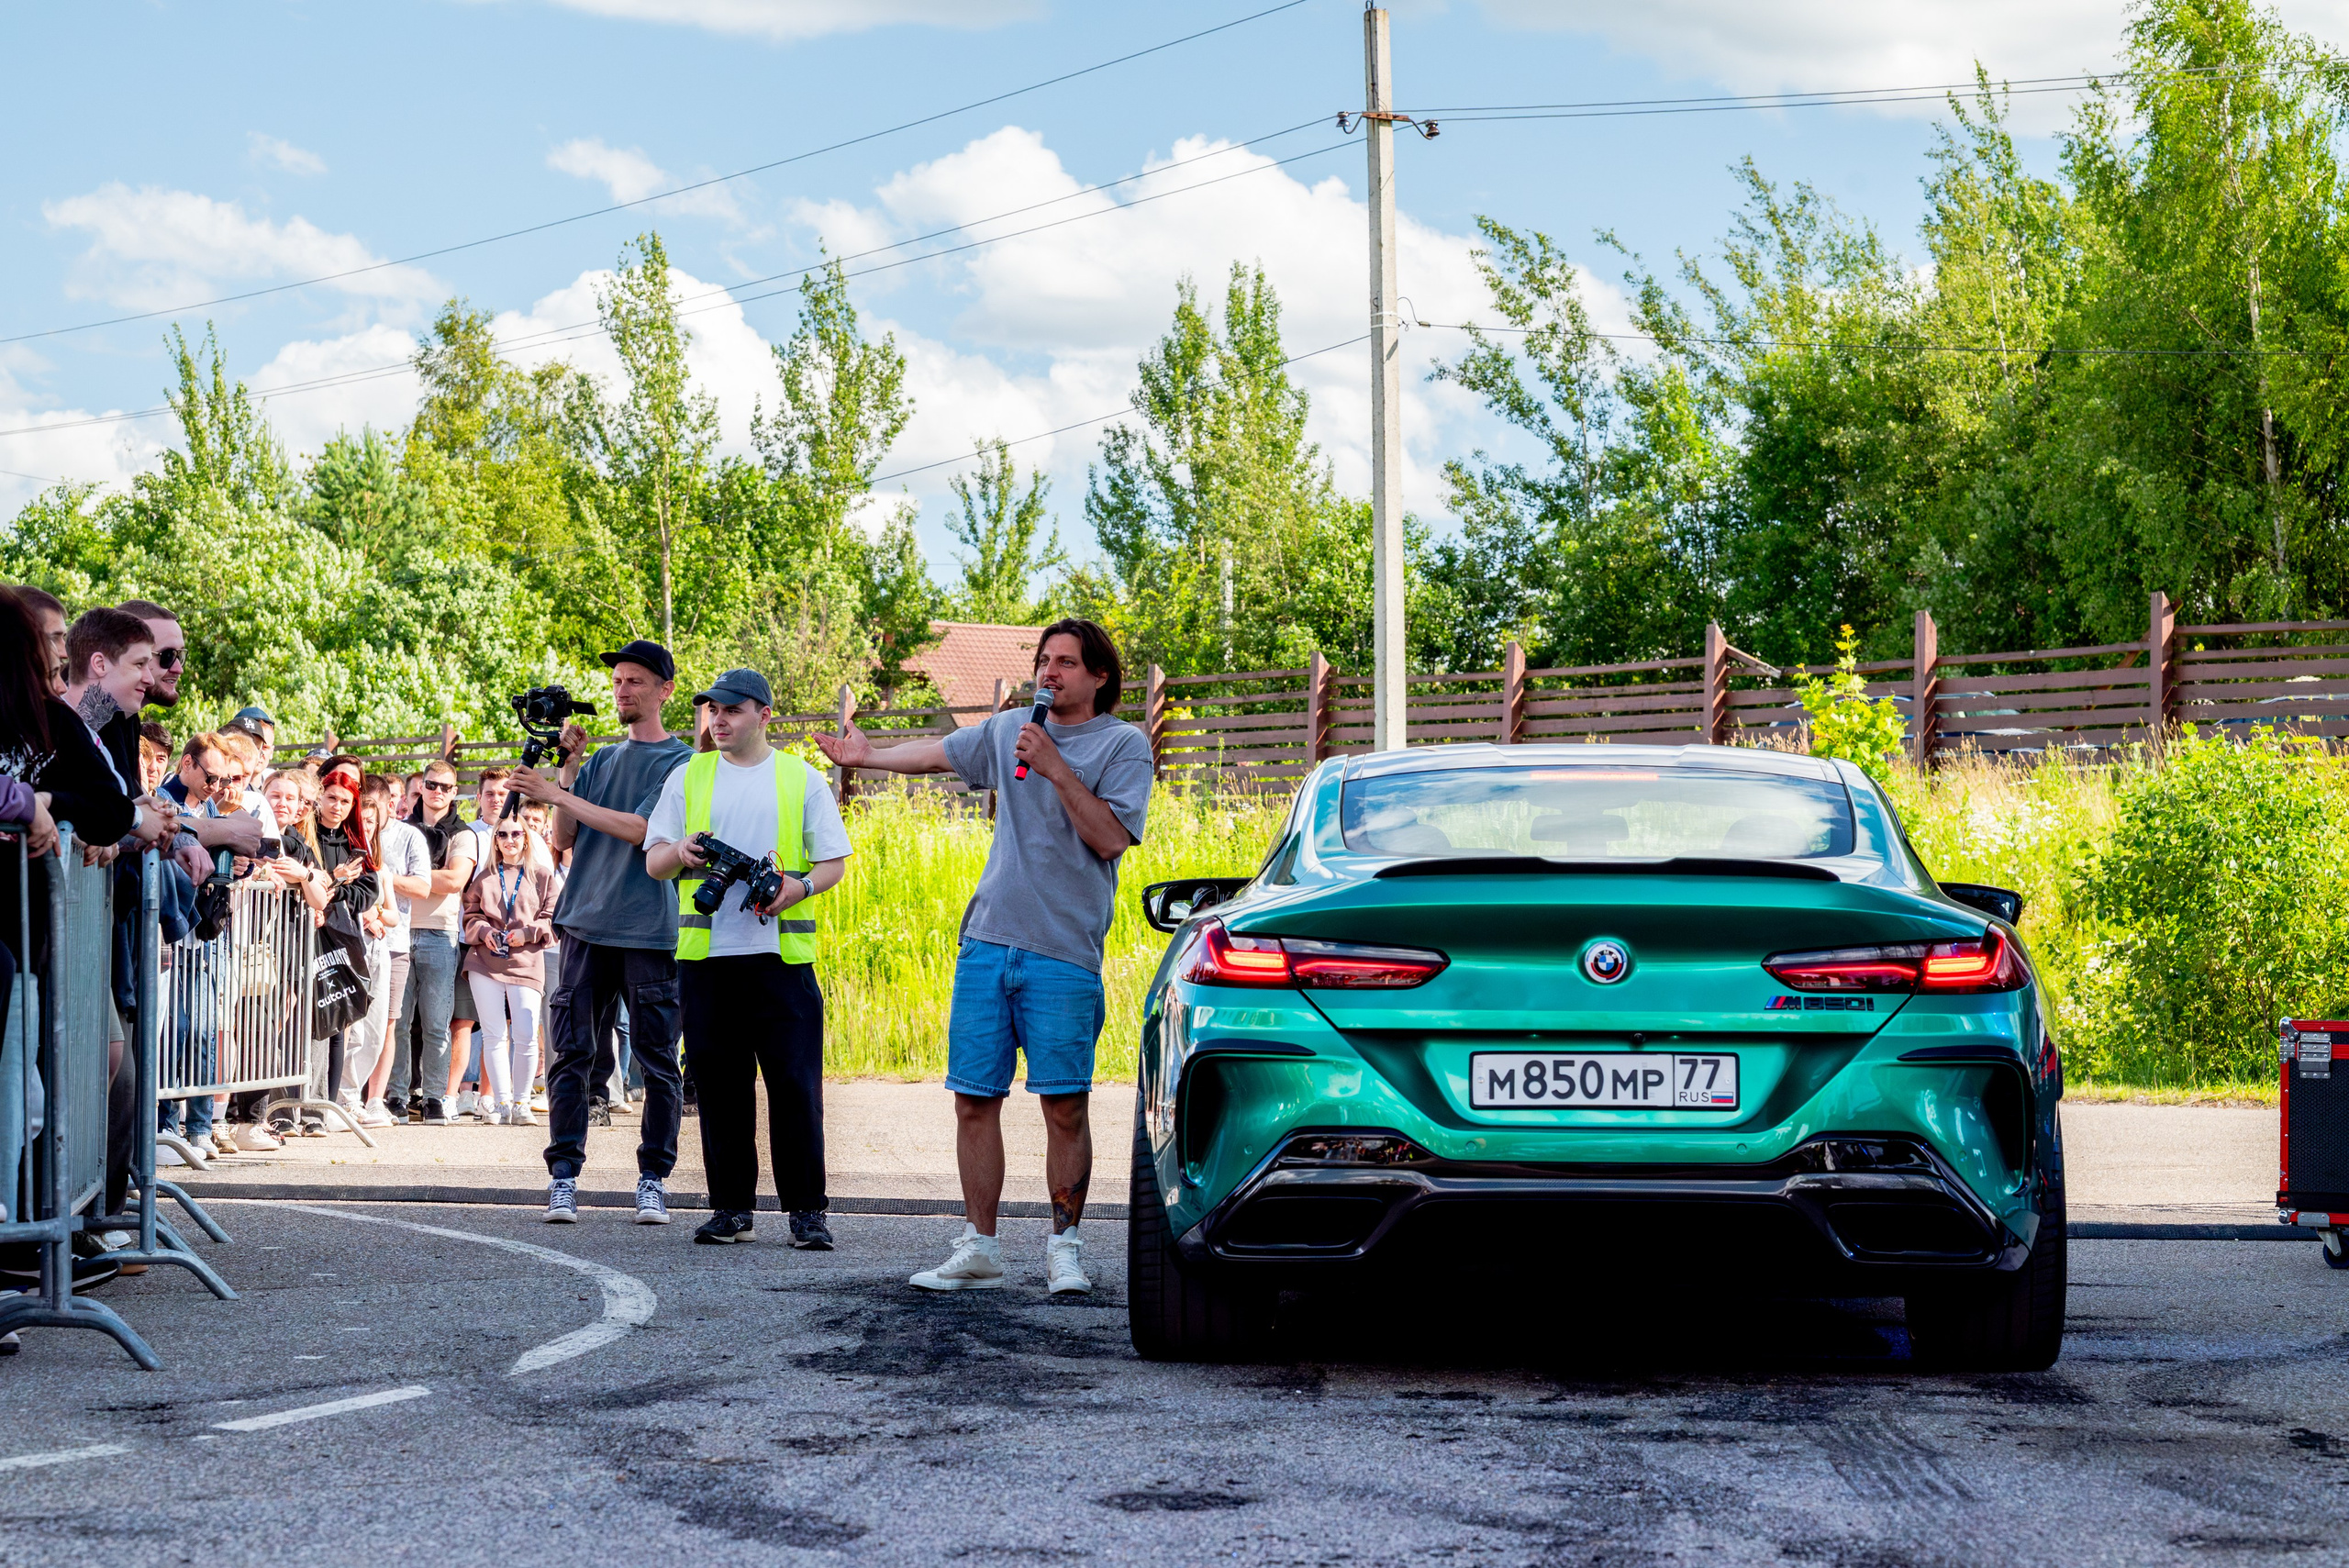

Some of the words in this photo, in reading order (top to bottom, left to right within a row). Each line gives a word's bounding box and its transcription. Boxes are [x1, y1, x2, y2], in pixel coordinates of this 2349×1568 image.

[243, 717, 255, 729] LA
[317, 985, 356, 1007] auto.ru
[1679, 1058, 1720, 1089] 77
[1678, 1091, 1709, 1103] RUS
